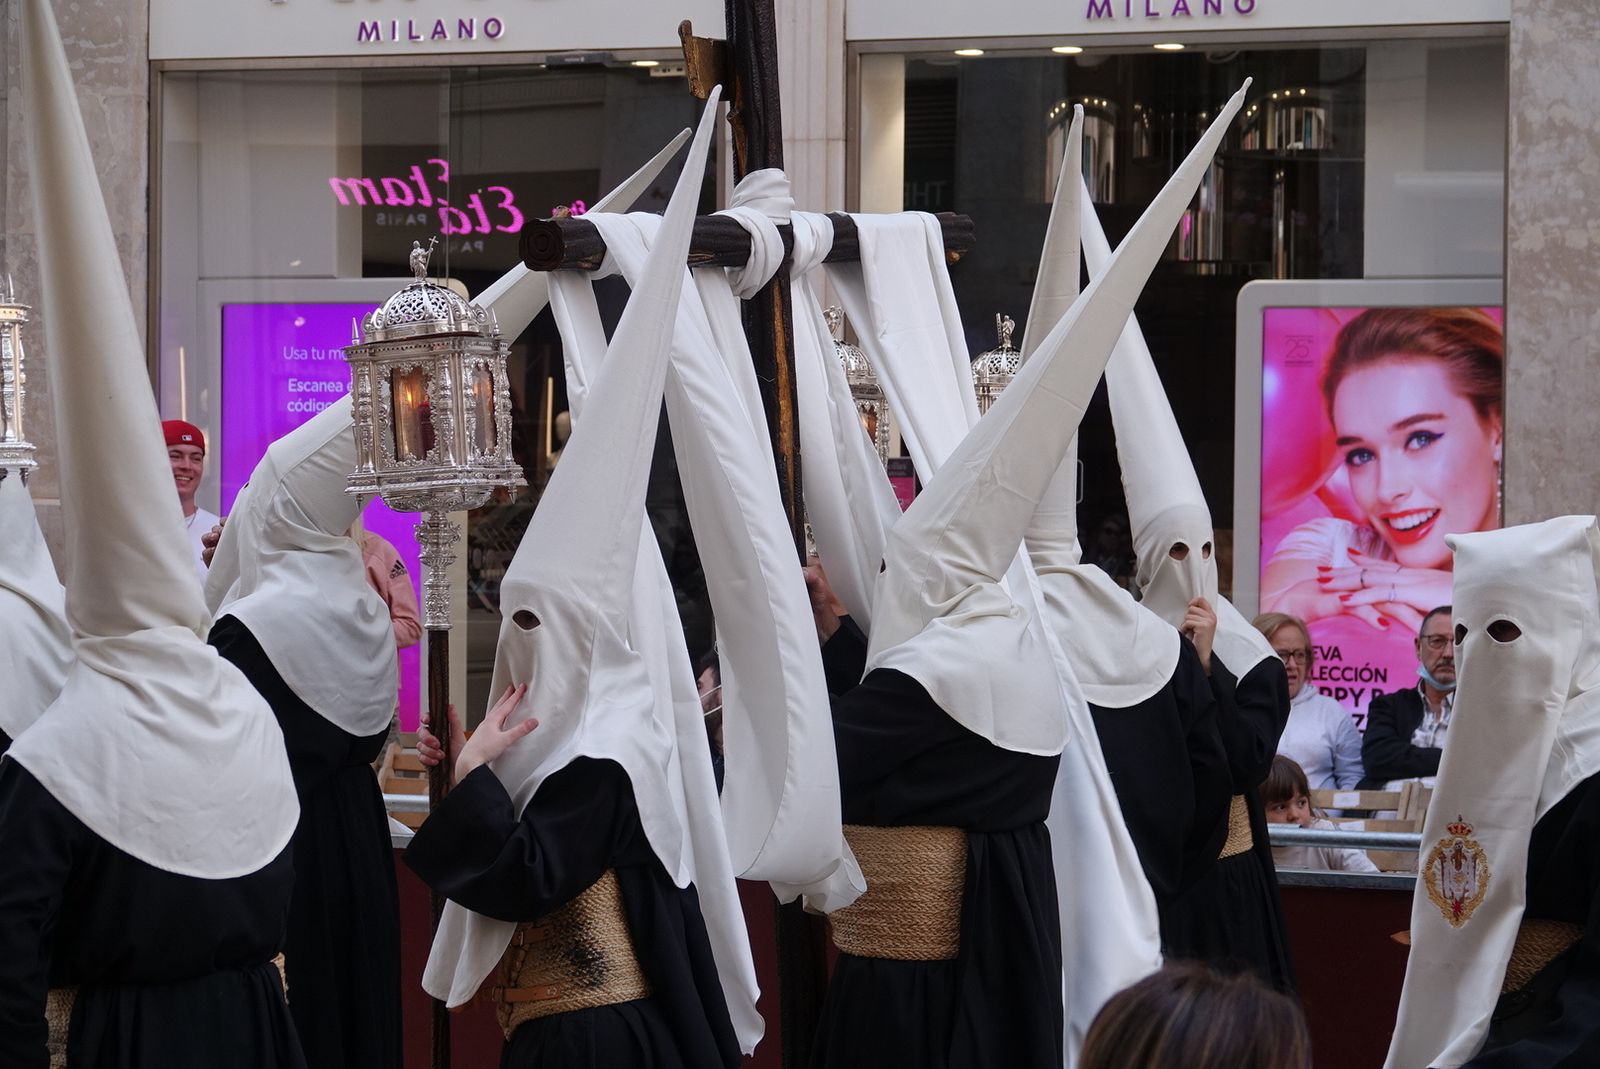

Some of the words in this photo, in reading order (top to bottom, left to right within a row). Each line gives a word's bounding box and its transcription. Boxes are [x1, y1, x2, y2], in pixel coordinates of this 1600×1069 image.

[1086, 0, 1255, 19] MILANO
[357, 17, 504, 42] MILANO
[283, 346, 308, 361] Usa
[311, 346, 325, 360] tu
[287, 378, 344, 393] Escanea
